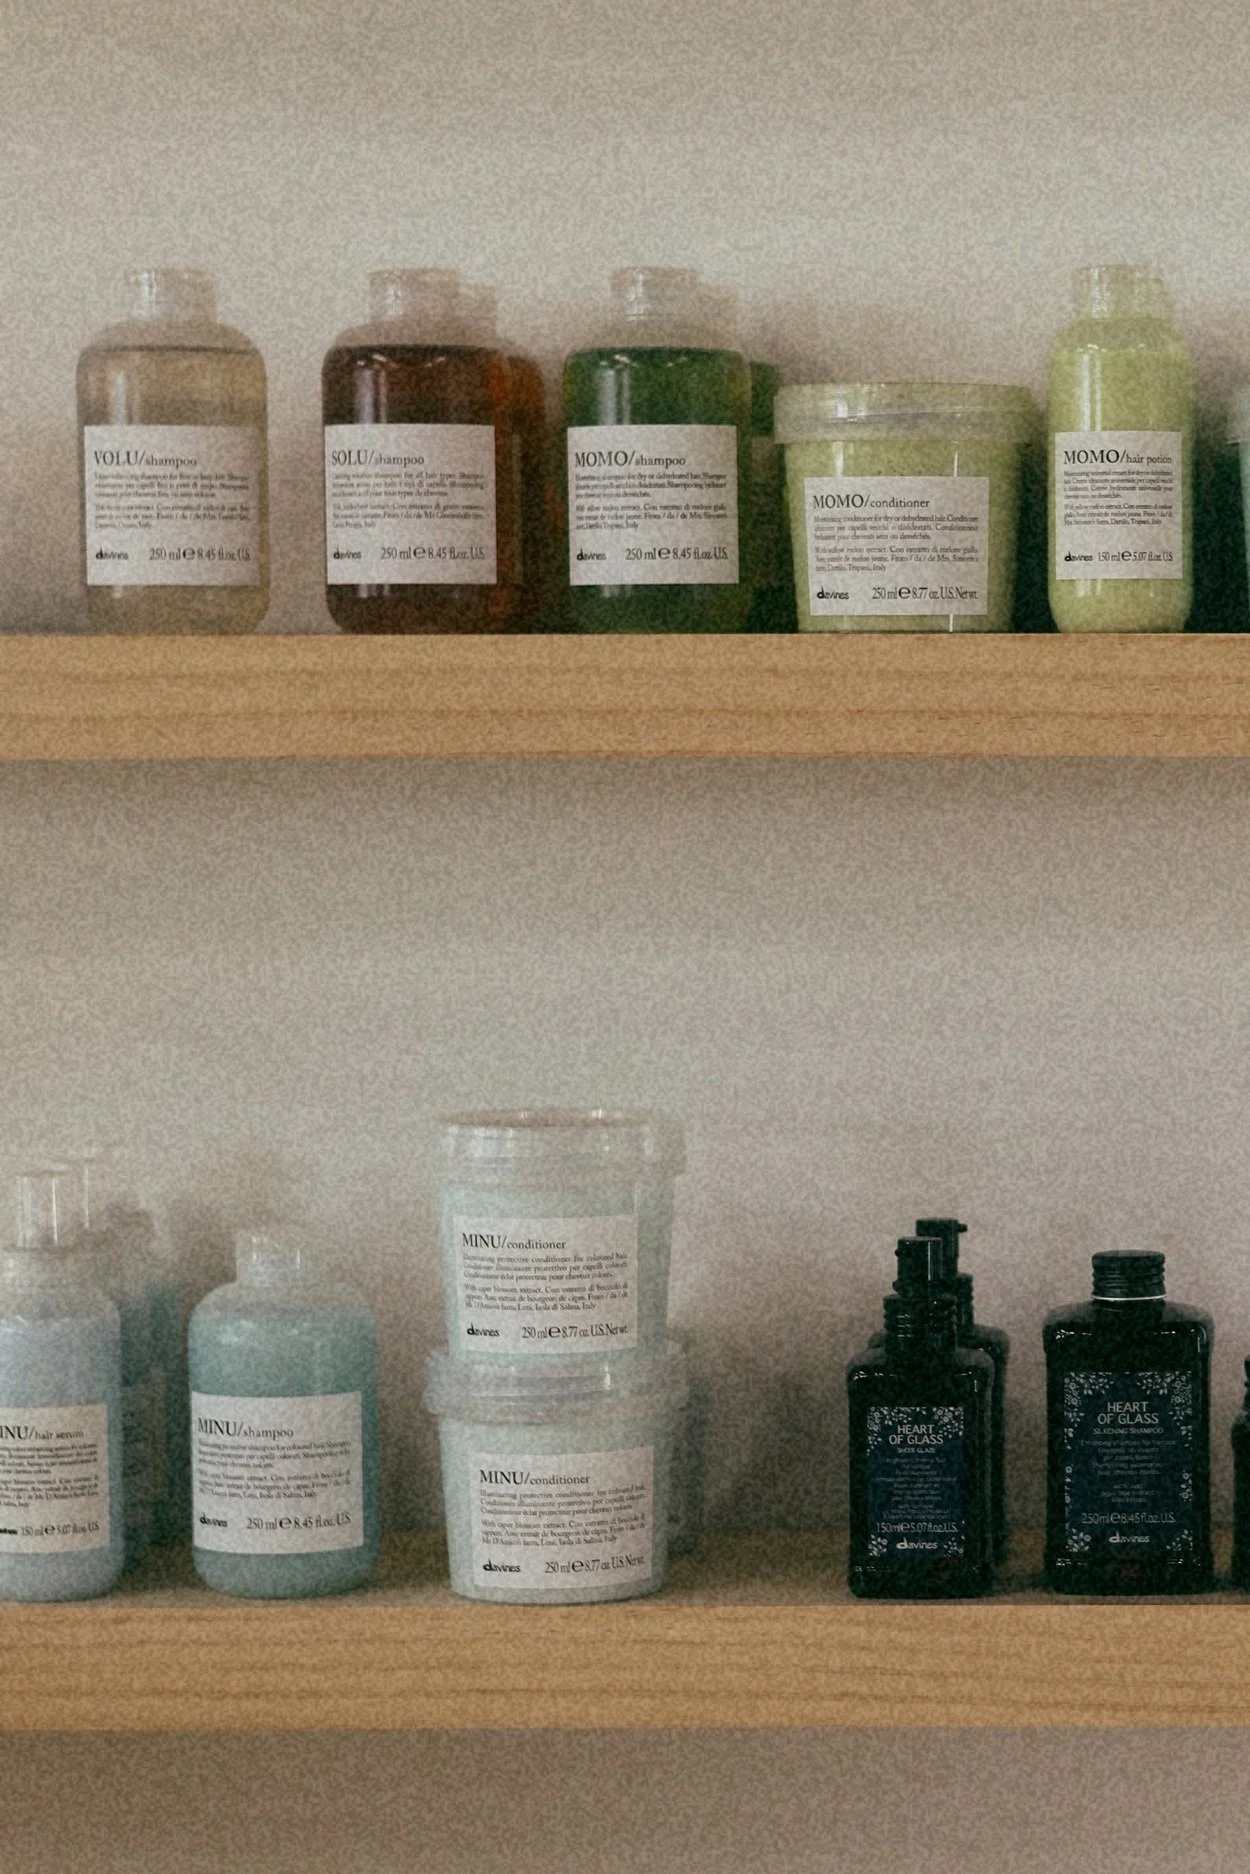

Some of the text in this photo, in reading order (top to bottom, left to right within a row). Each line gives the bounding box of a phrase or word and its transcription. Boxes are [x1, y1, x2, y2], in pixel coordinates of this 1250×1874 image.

[94, 450, 198, 469] VOLU/shampoo
[331, 450, 425, 468] SOLU/shampoo
[575, 450, 686, 469] MOMO/shampoo
[1064, 449, 1172, 465] MOMO/hair potion
[813, 494, 930, 509] MOMO/conditioner
[149, 548, 167, 560] 250
[169, 548, 181, 560] ml
[197, 548, 215, 560] 8.45
[380, 547, 397, 560] 250
[399, 547, 411, 560] ml
[427, 548, 447, 559] 8.45
[625, 548, 642, 560] 250
[644, 548, 656, 560] ml
[672, 548, 691, 560] 8.45
[1064, 551, 1093, 561] davines
[1098, 552, 1110, 561] 150
[1111, 552, 1120, 561] ml
[1132, 552, 1146, 561] 5.07
[817, 586, 849, 600] davines
[872, 588, 886, 600] 250
[887, 587, 898, 600] ml
[913, 587, 928, 600] 8.77
[462, 1232, 567, 1250] MINU/conditioner
[467, 1322, 500, 1337] davines
[522, 1326, 536, 1339] 250
[537, 1326, 548, 1339] ml
[562, 1325, 578, 1339] 8.77
[1107, 1402, 1149, 1412] HEART
[1097, 1413, 1159, 1425] OF GLASS
[197, 1417, 294, 1440] MINU/shampoo
[898, 1425, 934, 1434] HEART
[55, 1432, 84, 1440] serum
[889, 1434, 943, 1444] OF GLASS
[479, 1469, 590, 1485] MINU/conditioner
[247, 1517, 264, 1530] 250
[265, 1517, 278, 1530] ml
[294, 1515, 313, 1529] 8.45
[896, 1536, 938, 1550] davines
[1109, 1530, 1150, 1543] davines
[482, 1558, 521, 1573] davines
[545, 1561, 559, 1574] 250
[560, 1560, 571, 1573] ml
